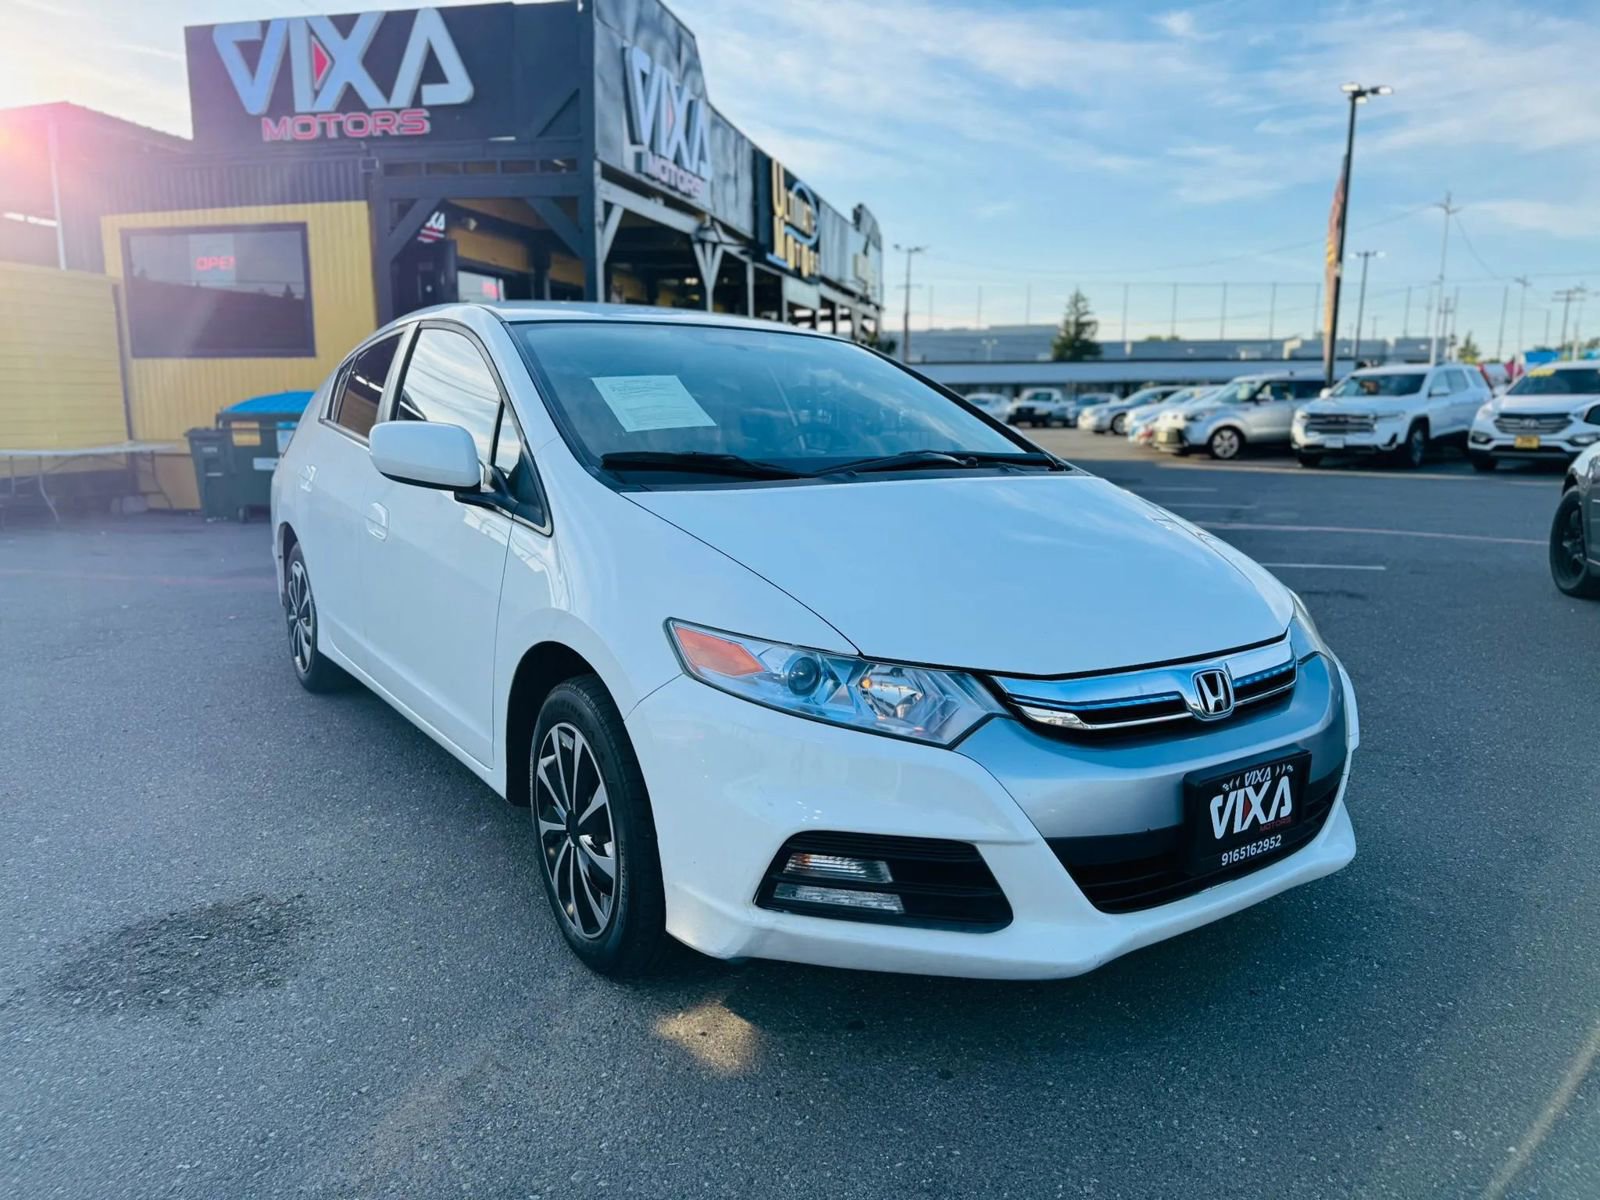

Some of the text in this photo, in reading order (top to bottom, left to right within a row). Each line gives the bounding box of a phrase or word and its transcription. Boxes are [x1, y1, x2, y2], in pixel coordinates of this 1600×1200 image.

[212, 7, 475, 115] VIXA
[261, 109, 430, 141] MOTORS
[626, 46, 713, 180] VIXA
[1244, 766, 1271, 787] VIXA
[1209, 775, 1293, 840] VIXA
[1221, 834, 1282, 866] 9165162952
